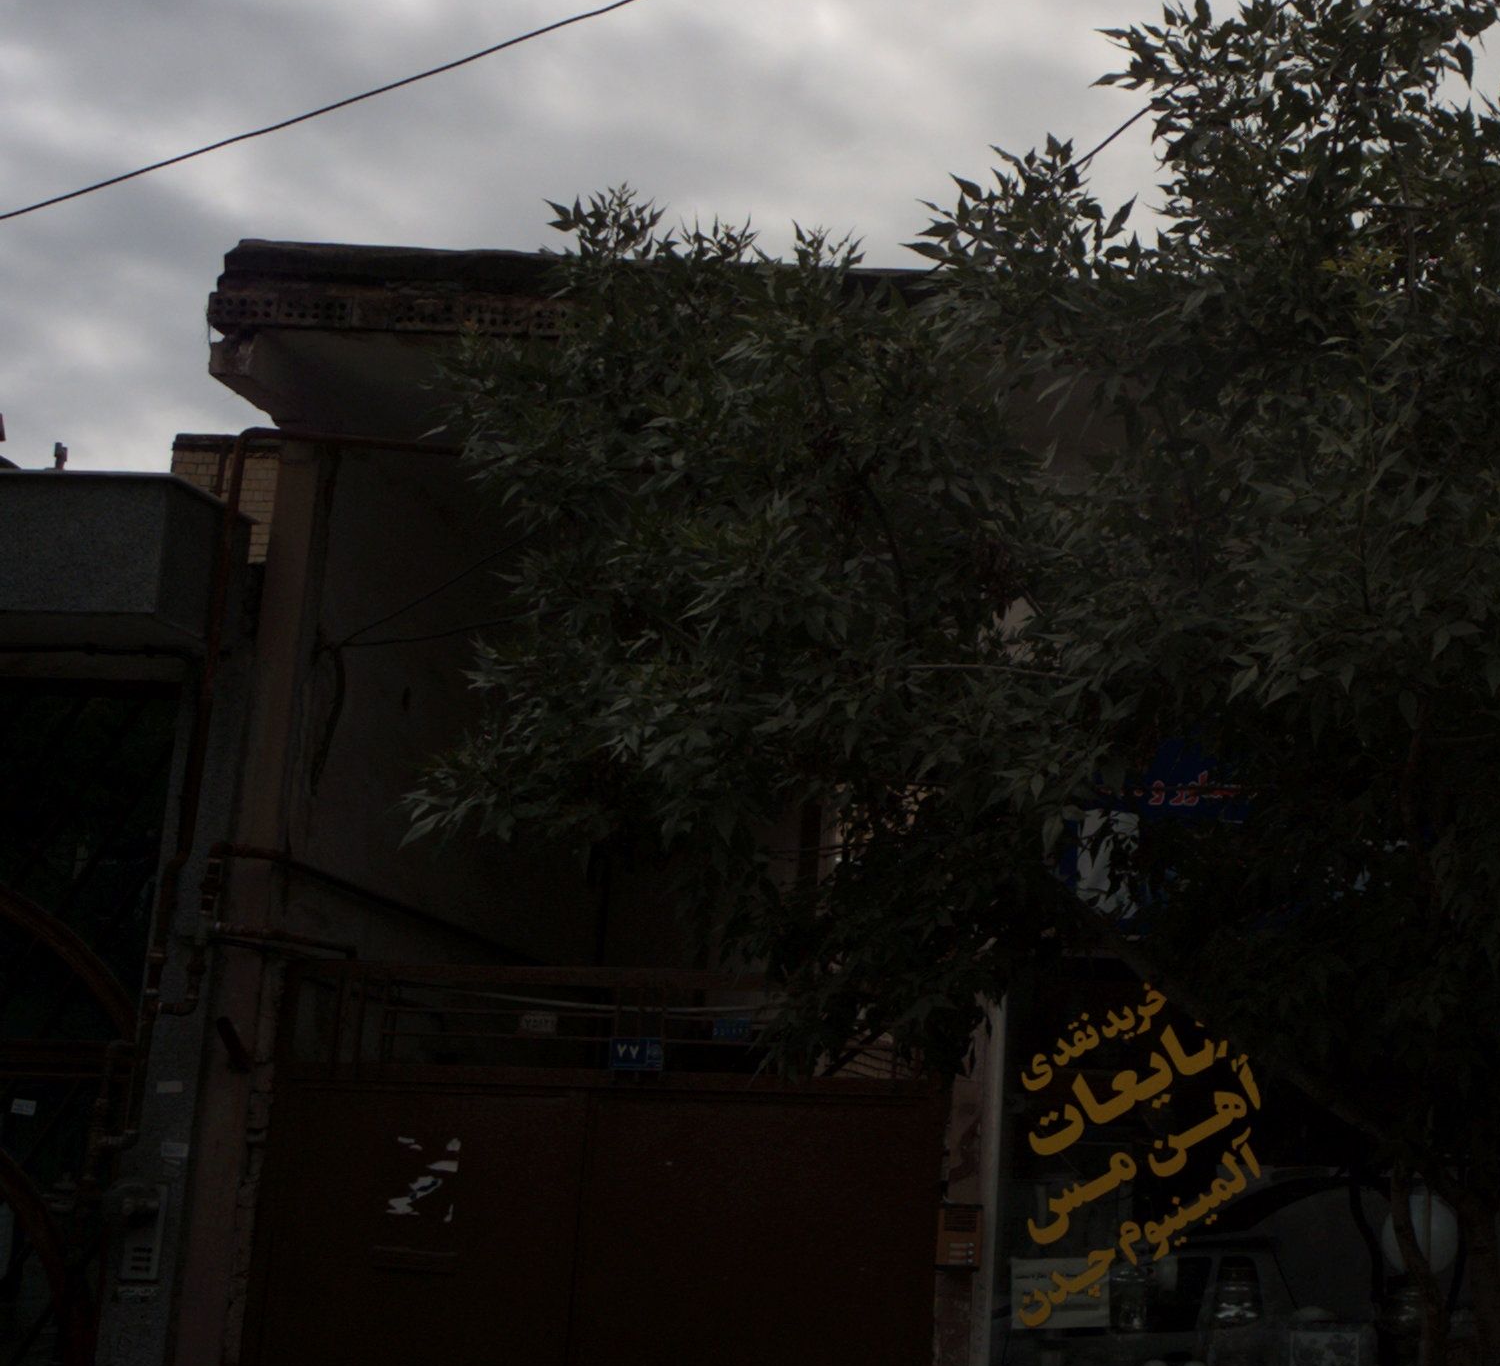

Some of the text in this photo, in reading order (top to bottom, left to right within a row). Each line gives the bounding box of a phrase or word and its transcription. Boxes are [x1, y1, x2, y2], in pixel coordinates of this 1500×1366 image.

[1020, 981, 1168, 1092] خرید نقدی
[1026, 1150, 1138, 1246] مس
[1017, 1246, 1118, 1328] چدن
